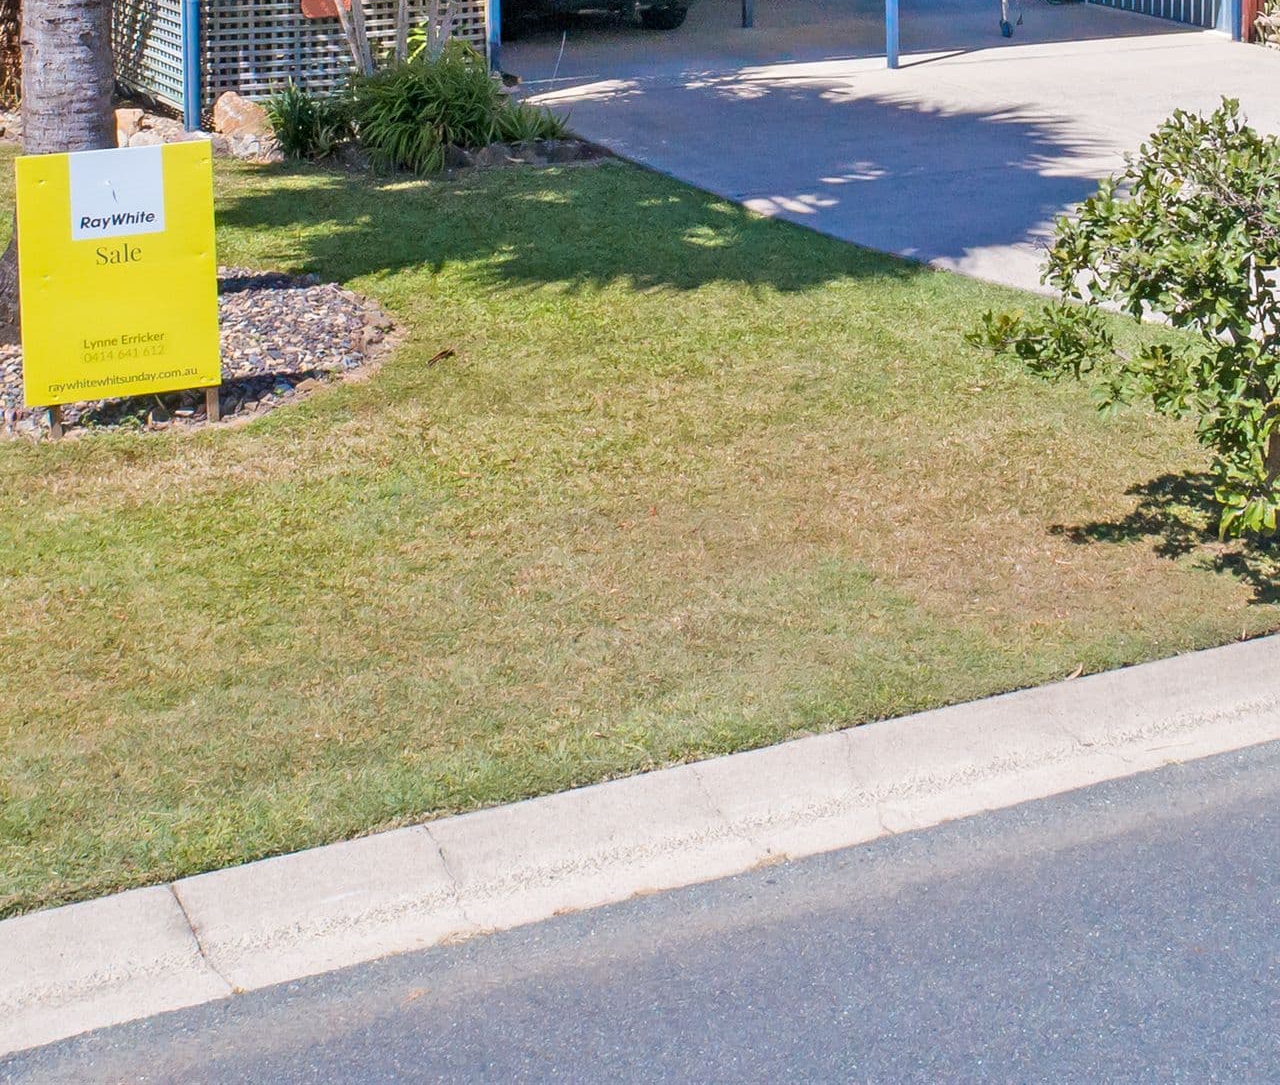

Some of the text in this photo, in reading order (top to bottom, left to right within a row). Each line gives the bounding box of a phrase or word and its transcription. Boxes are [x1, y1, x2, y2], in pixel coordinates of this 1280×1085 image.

[96, 243, 142, 266] Sale
[83, 331, 165, 350] Lynne Erricker
[48, 367, 199, 393] raywhitewhitsunday.com.au
